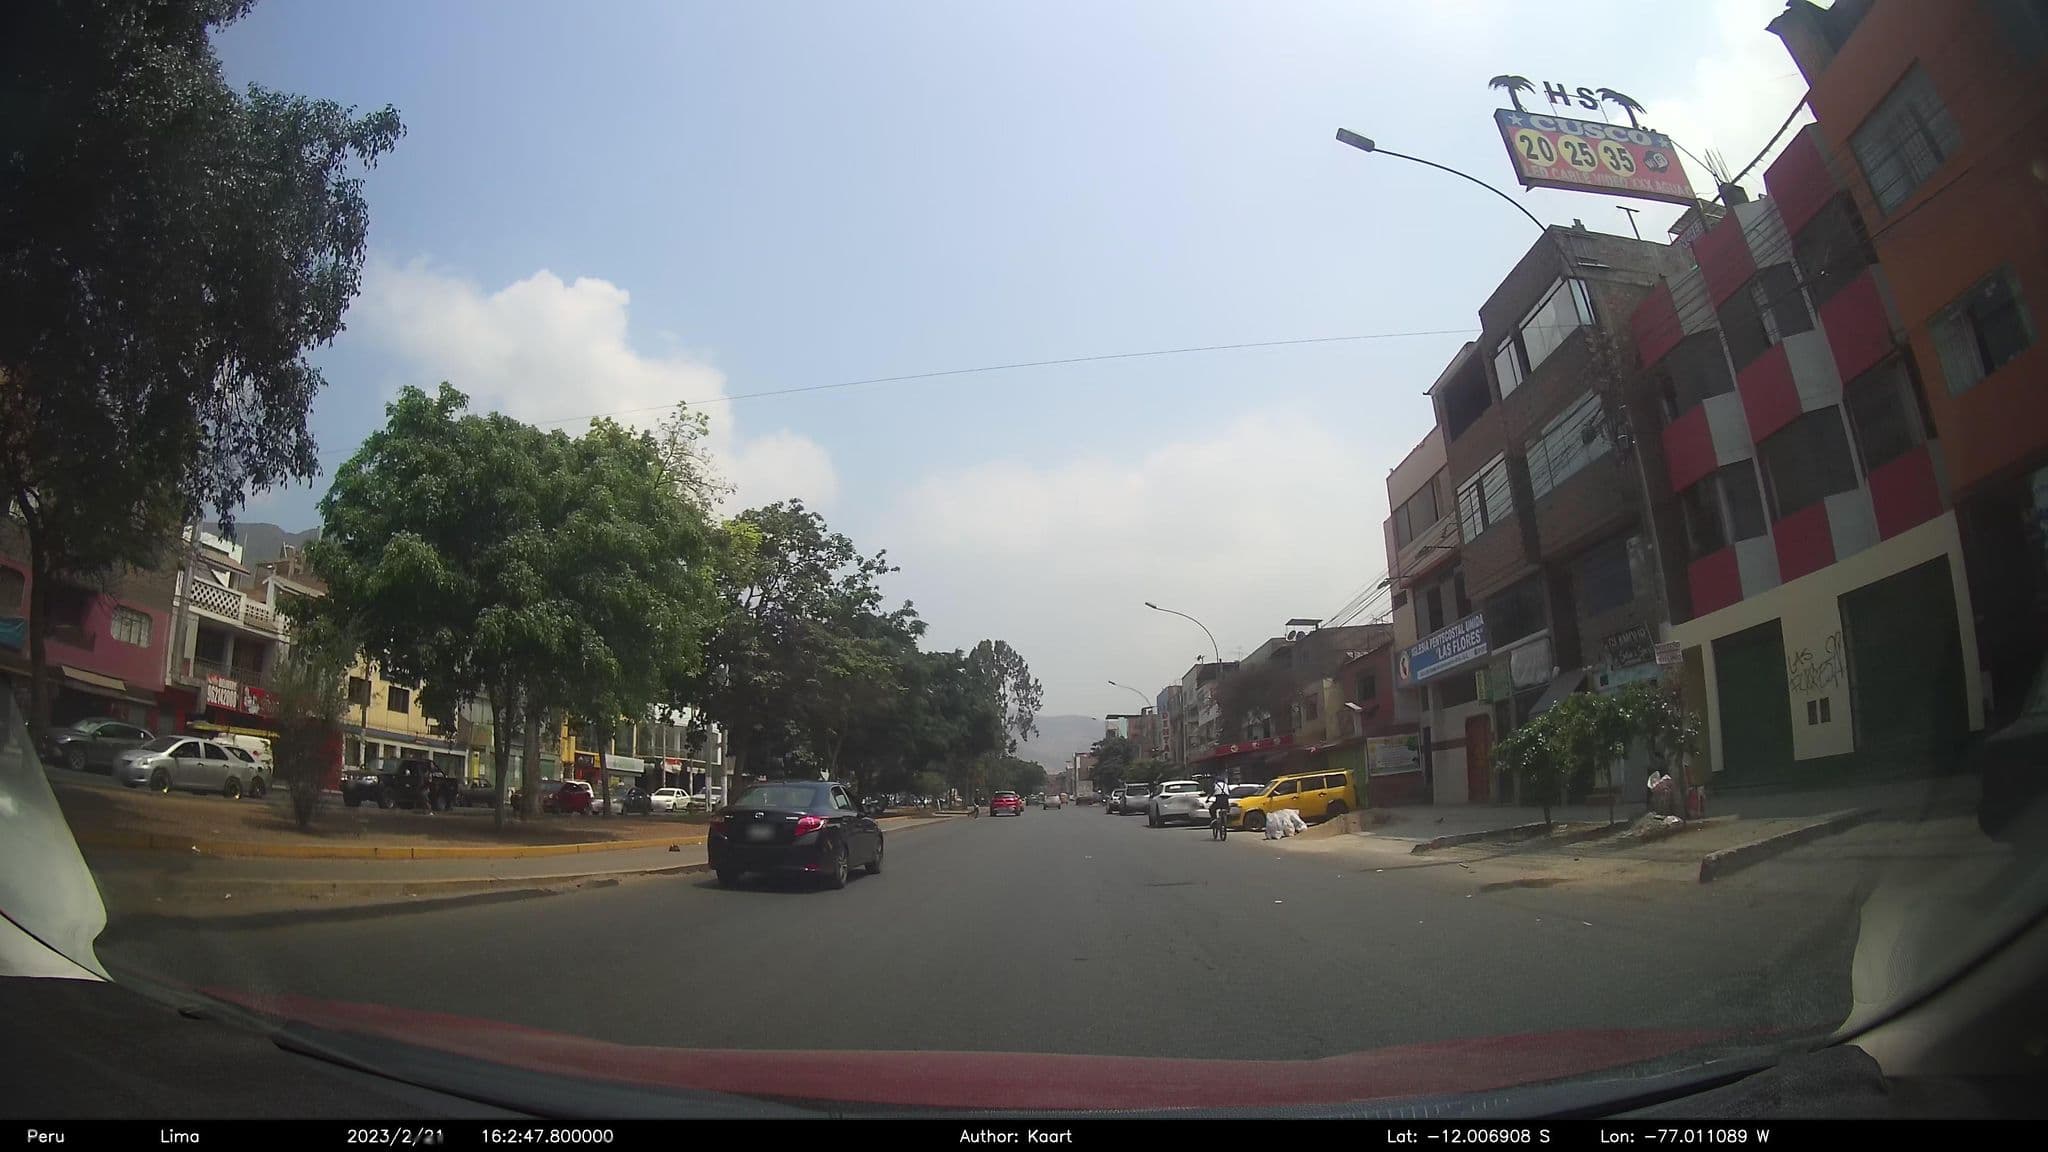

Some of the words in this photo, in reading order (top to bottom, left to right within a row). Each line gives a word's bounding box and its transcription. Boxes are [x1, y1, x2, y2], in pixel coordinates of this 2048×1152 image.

[1530, 113, 1653, 146] CUSCO
[1519, 134, 1554, 162] 20
[1564, 140, 1596, 170] 25
[1603, 145, 1635, 173] 35
[1429, 624, 1465, 649] PENTECOSTAL
